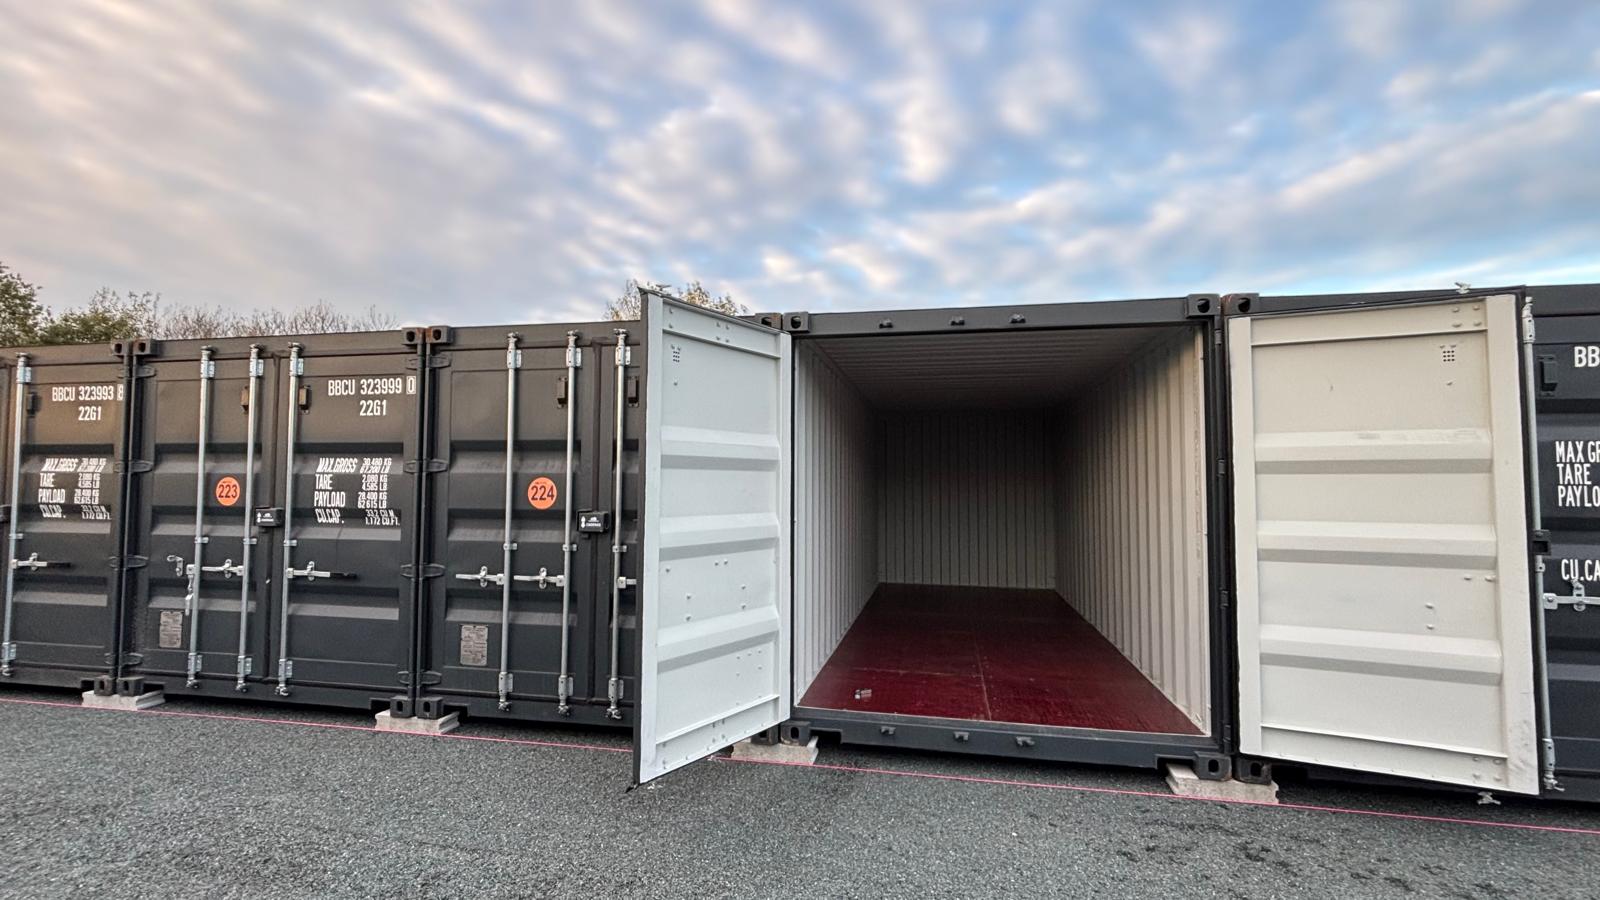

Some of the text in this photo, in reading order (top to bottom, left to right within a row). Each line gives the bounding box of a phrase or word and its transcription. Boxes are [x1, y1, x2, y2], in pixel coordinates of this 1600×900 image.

[52, 384, 124, 401] BBCU 323993 8
[328, 376, 416, 396] BBCU 323999 0
[78, 406, 102, 420] 22G1
[360, 399, 387, 416] 22G1
[1555, 441, 1585, 463] MAX
[383, 458, 392, 466] KG
[40, 473, 56, 487] TARE
[315, 474, 333, 489] TARE
[379, 474, 388, 483] KG
[1556, 464, 1592, 485] TARE
[218, 484, 238, 499] 223
[379, 482, 388, 491] LB
[531, 485, 555, 501] 224
[38, 489, 66, 503] PAYLOAD
[314, 491, 346, 507] PAYLOAD
[379, 491, 388, 500] KG
[1558, 485, 1600, 507] PAYLO
[378, 500, 387, 509] LB
